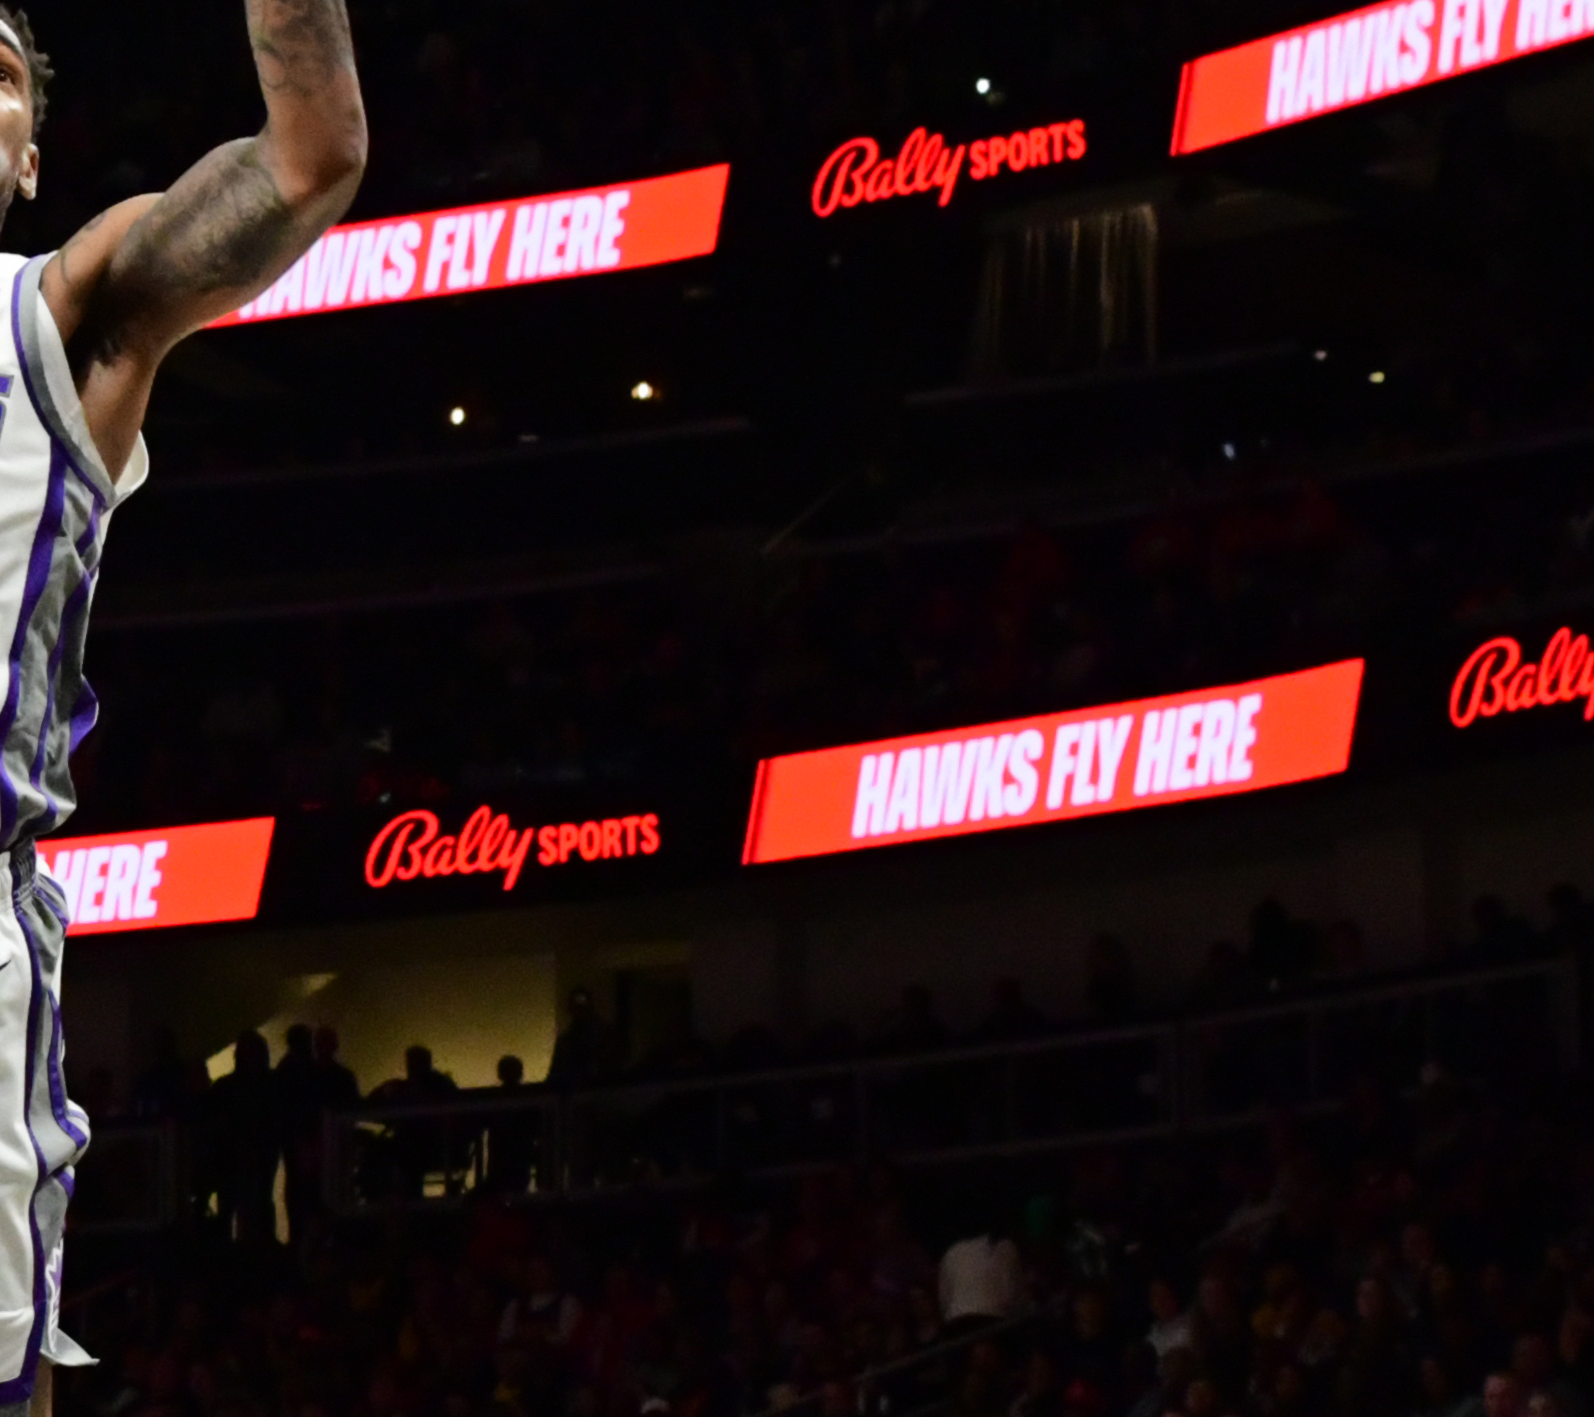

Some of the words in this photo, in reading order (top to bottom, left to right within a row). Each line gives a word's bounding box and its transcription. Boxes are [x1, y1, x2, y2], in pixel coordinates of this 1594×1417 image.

[812, 127, 966, 218] Bally
[968, 119, 1087, 181] SPORTS
[238, 221, 423, 319] AWKS
[421, 207, 519, 294] FLY
[506, 191, 632, 281] HERE
[850, 727, 1044, 840] HAWKS
[1046, 713, 1135, 811] FLY
[1131, 692, 1262, 799] HERE
[53, 840, 169, 924] HERE
[364, 804, 534, 891] Bally
[536, 813, 660, 867] SPORTS
